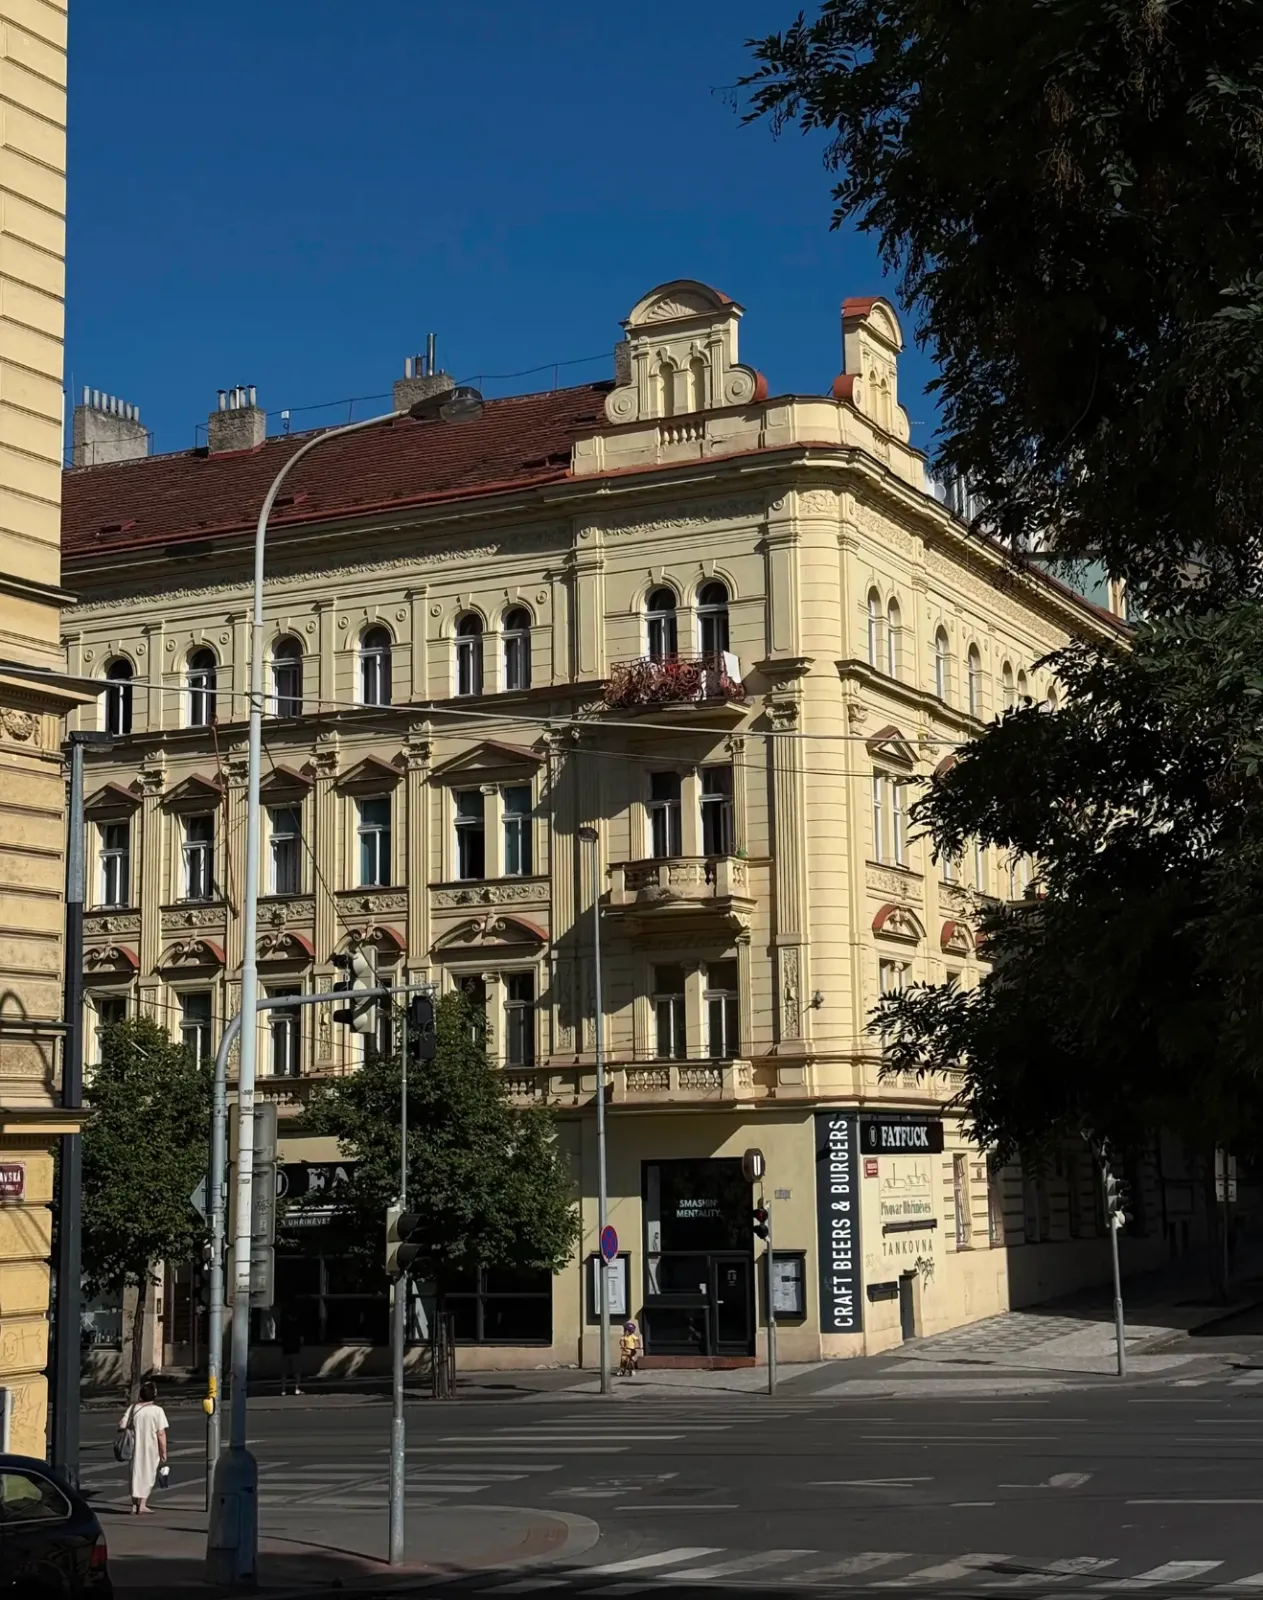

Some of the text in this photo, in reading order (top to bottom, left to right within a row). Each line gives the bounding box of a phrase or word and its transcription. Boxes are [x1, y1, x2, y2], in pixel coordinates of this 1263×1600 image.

[881, 1126, 929, 1147] FATFUCK
[676, 1209, 721, 1218] MENTALITY
[829, 1120, 854, 1327] CRAFT BEERS & BURGERS
[882, 1238, 934, 1256] TANKOVNA
